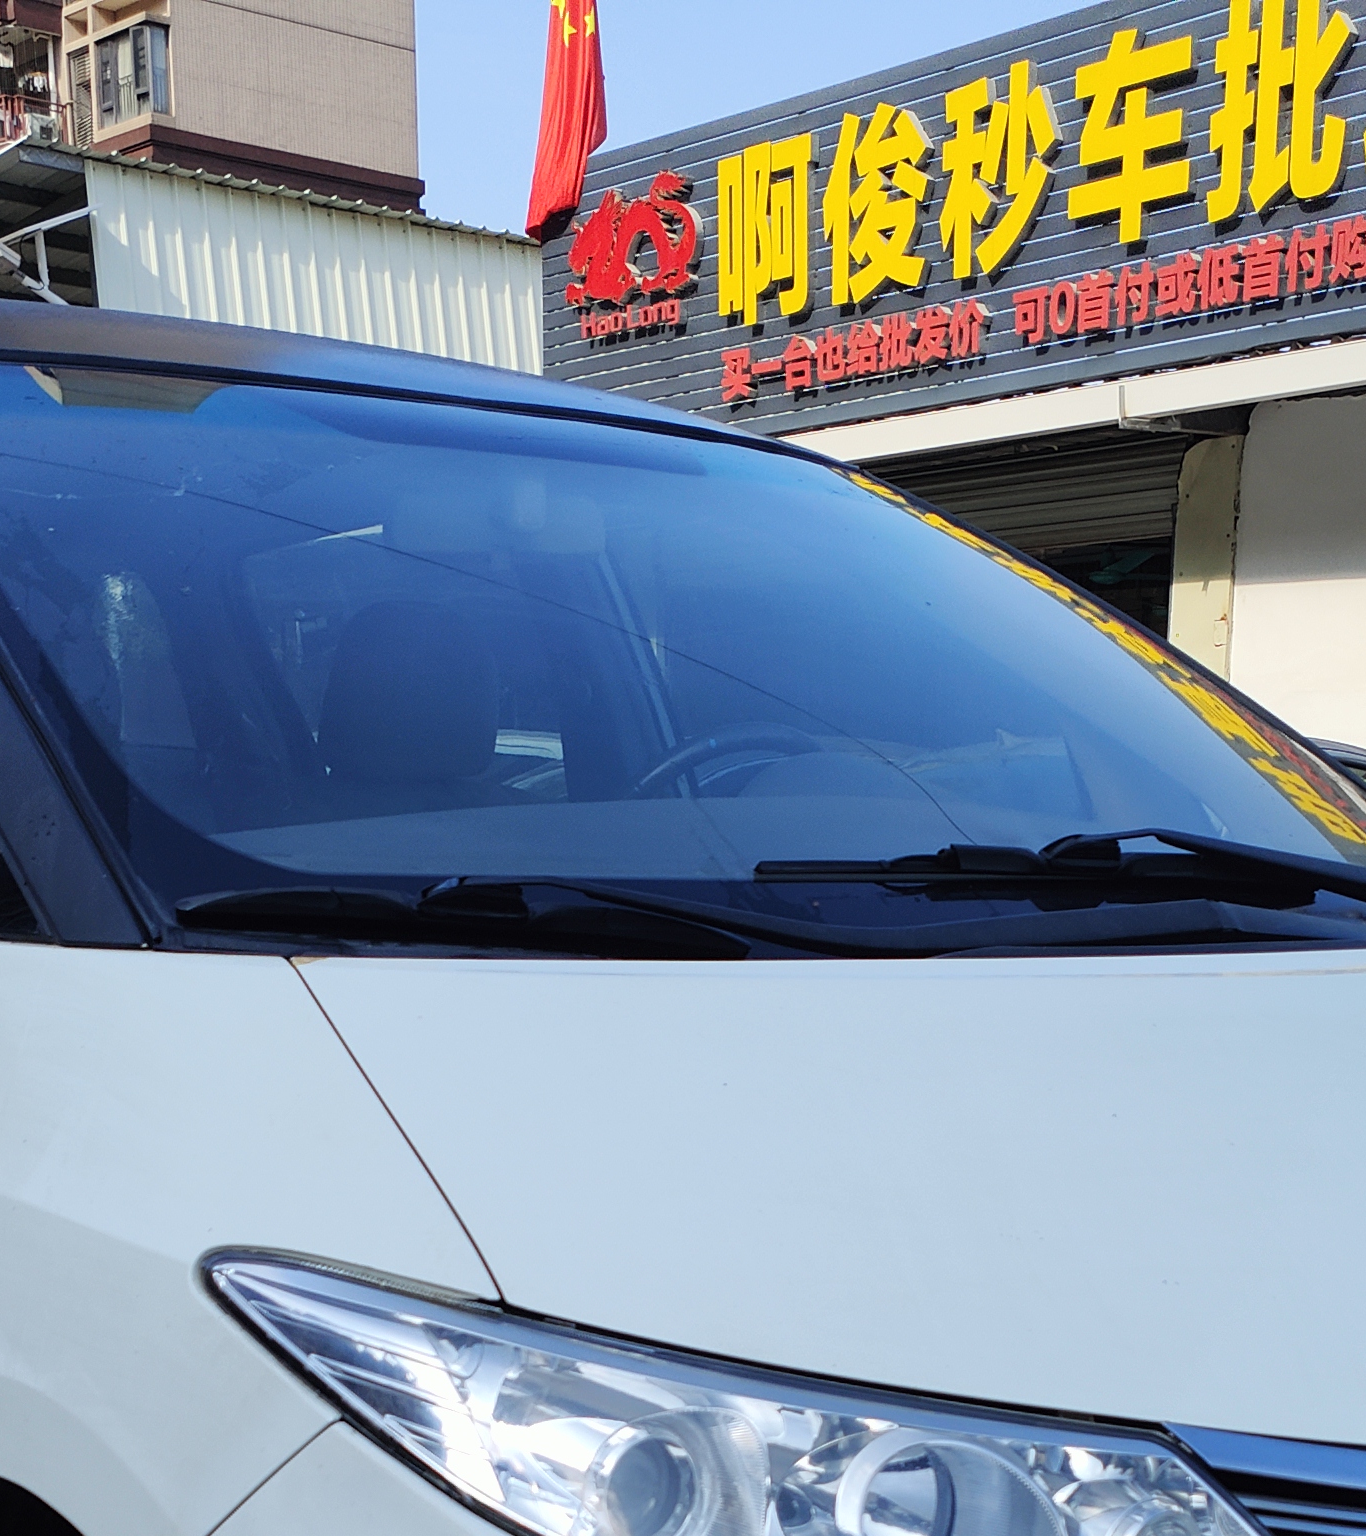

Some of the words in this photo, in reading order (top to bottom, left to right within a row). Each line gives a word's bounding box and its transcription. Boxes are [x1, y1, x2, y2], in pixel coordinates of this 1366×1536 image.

[720, 299, 985, 402] 买一台也给批发价
